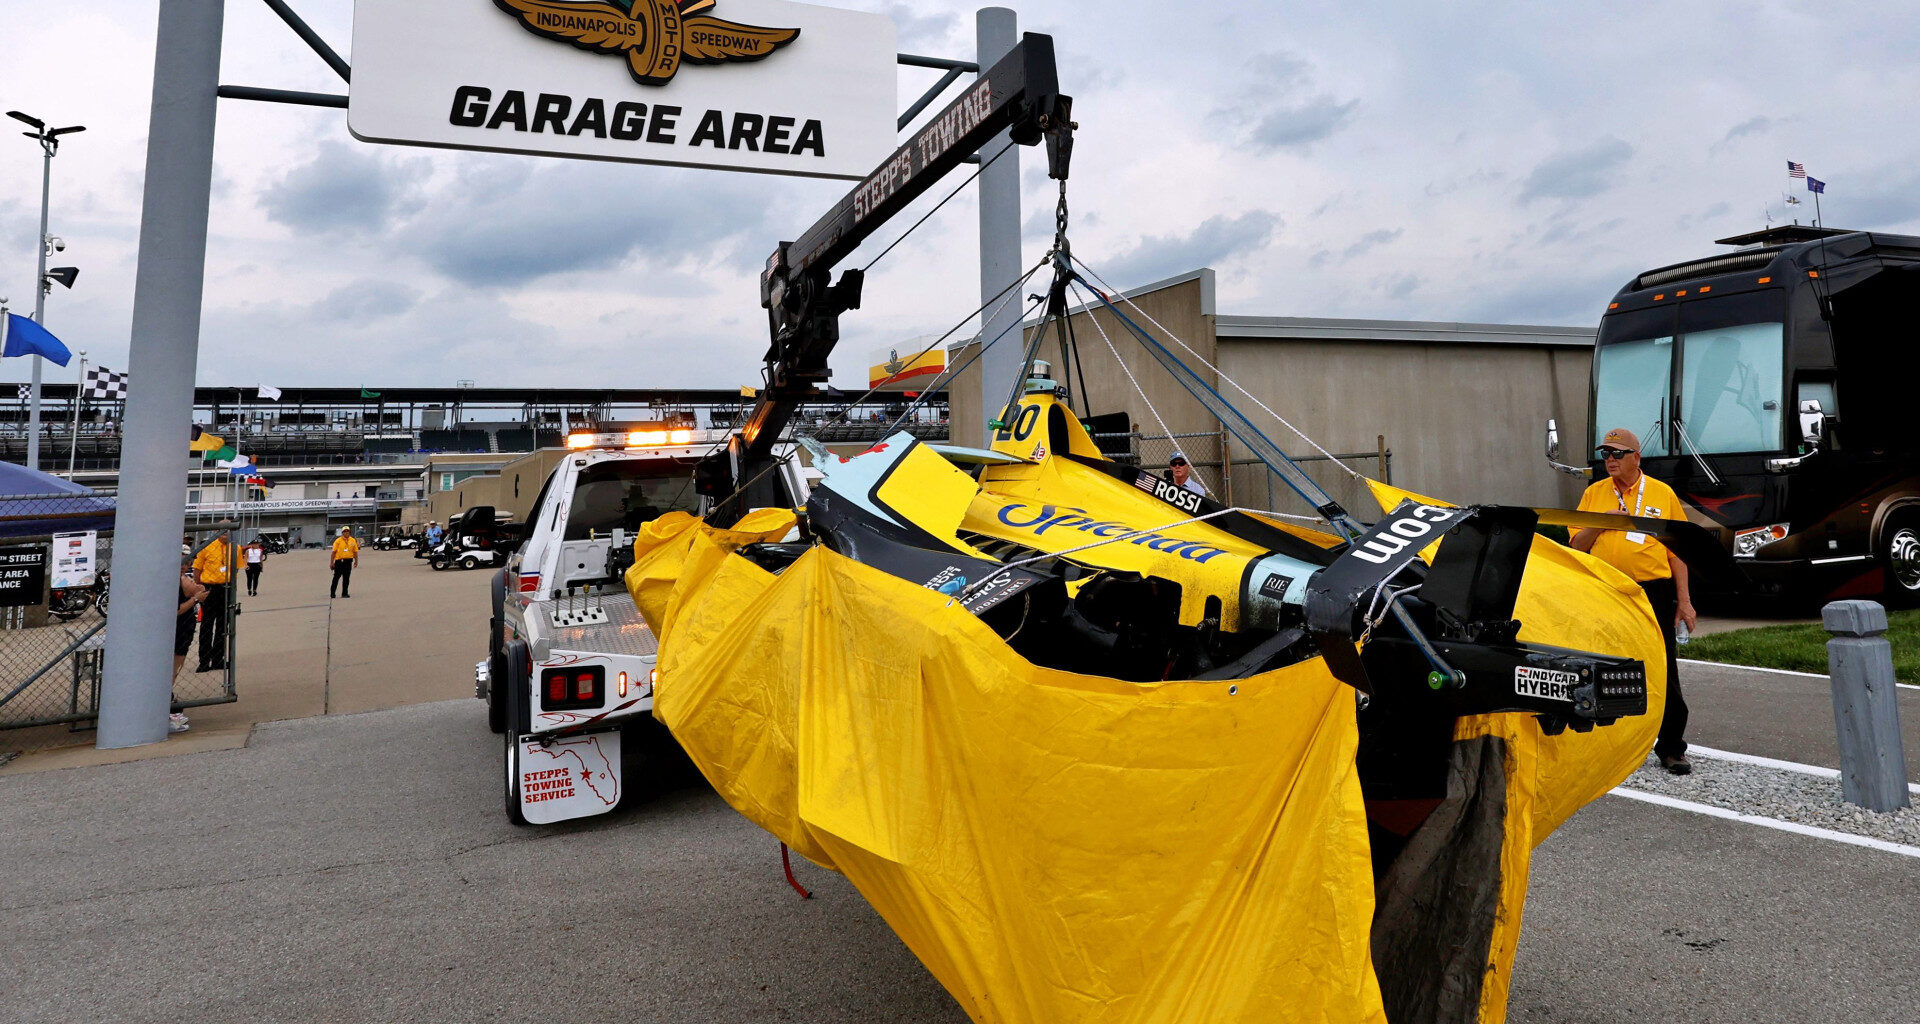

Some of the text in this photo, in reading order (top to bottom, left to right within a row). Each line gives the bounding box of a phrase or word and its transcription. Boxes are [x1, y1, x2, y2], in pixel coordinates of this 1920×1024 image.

[536, 11, 637, 37] INDIANAPOLIS
[658, 2, 678, 70] MOTOR
[691, 31, 761, 52] SPEEDWAY
[450, 85, 825, 157] GARAGE AREA
[853, 79, 992, 223] STEPP'S TOWING
[996, 404, 1041, 442] 20
[241, 501, 280, 509] INDIANAPOLIS
[1154, 480, 1202, 513] ROSSI
[9, 554, 43, 563] STREET
[4, 570, 30, 578] AREA
[961, 571, 1012, 607] Splen
[1528, 670, 1577, 685] INDYCAR
[524, 767, 569, 782] STEPPS
[524, 778, 573, 793] TOWING
[525, 788, 575, 804] SERVICE
